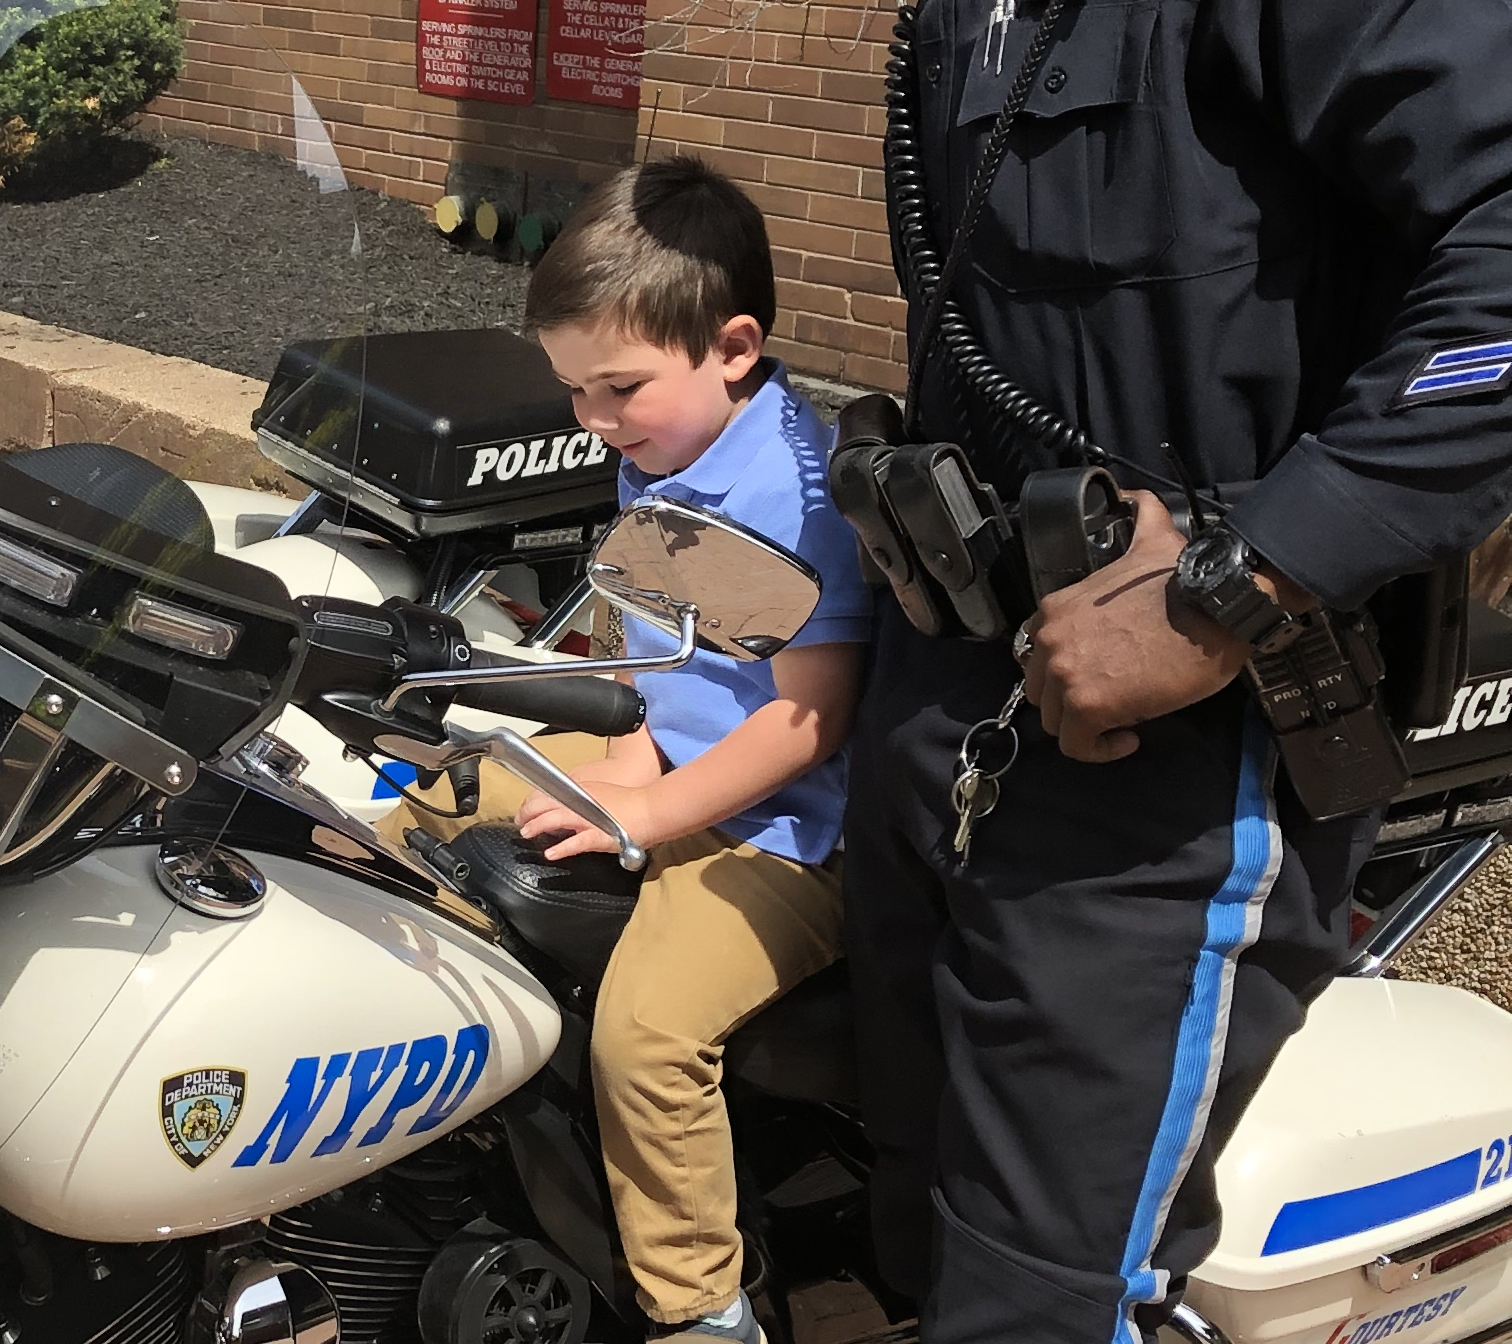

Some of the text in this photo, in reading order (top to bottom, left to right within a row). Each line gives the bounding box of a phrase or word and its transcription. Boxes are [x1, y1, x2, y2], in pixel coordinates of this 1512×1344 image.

[563, 0, 598, 12] SERVING
[421, 21, 532, 42] SERVING SPRINKLERS FROM
[567, 13, 640, 29] THE CELLAR & THE
[560, 26, 592, 40] CELLAR
[426, 34, 529, 54] THE STREET LEVEL TO THE
[422, 47, 532, 68] ROOF AND THE GENERATOR
[553, 52, 583, 66] EXCEPT
[586, 56, 600, 68] THE
[425, 60, 529, 81] & ELECTRIC SWITCH GEAR
[562, 67, 600, 81] ELECTRIC
[425, 73, 526, 94] ROOMS ON THE SC LEVEL
[592, 85, 623, 98] ROOMS
[466, 432, 608, 486] POLICE
[184, 1070, 230, 1087] POLICE
[165, 1083, 242, 1106] DEPARTMENT
[230, 1024, 490, 1168] NYPD
[164, 1116, 188, 1156] CITY OF
[202, 1104, 240, 1156] NEW YORK
